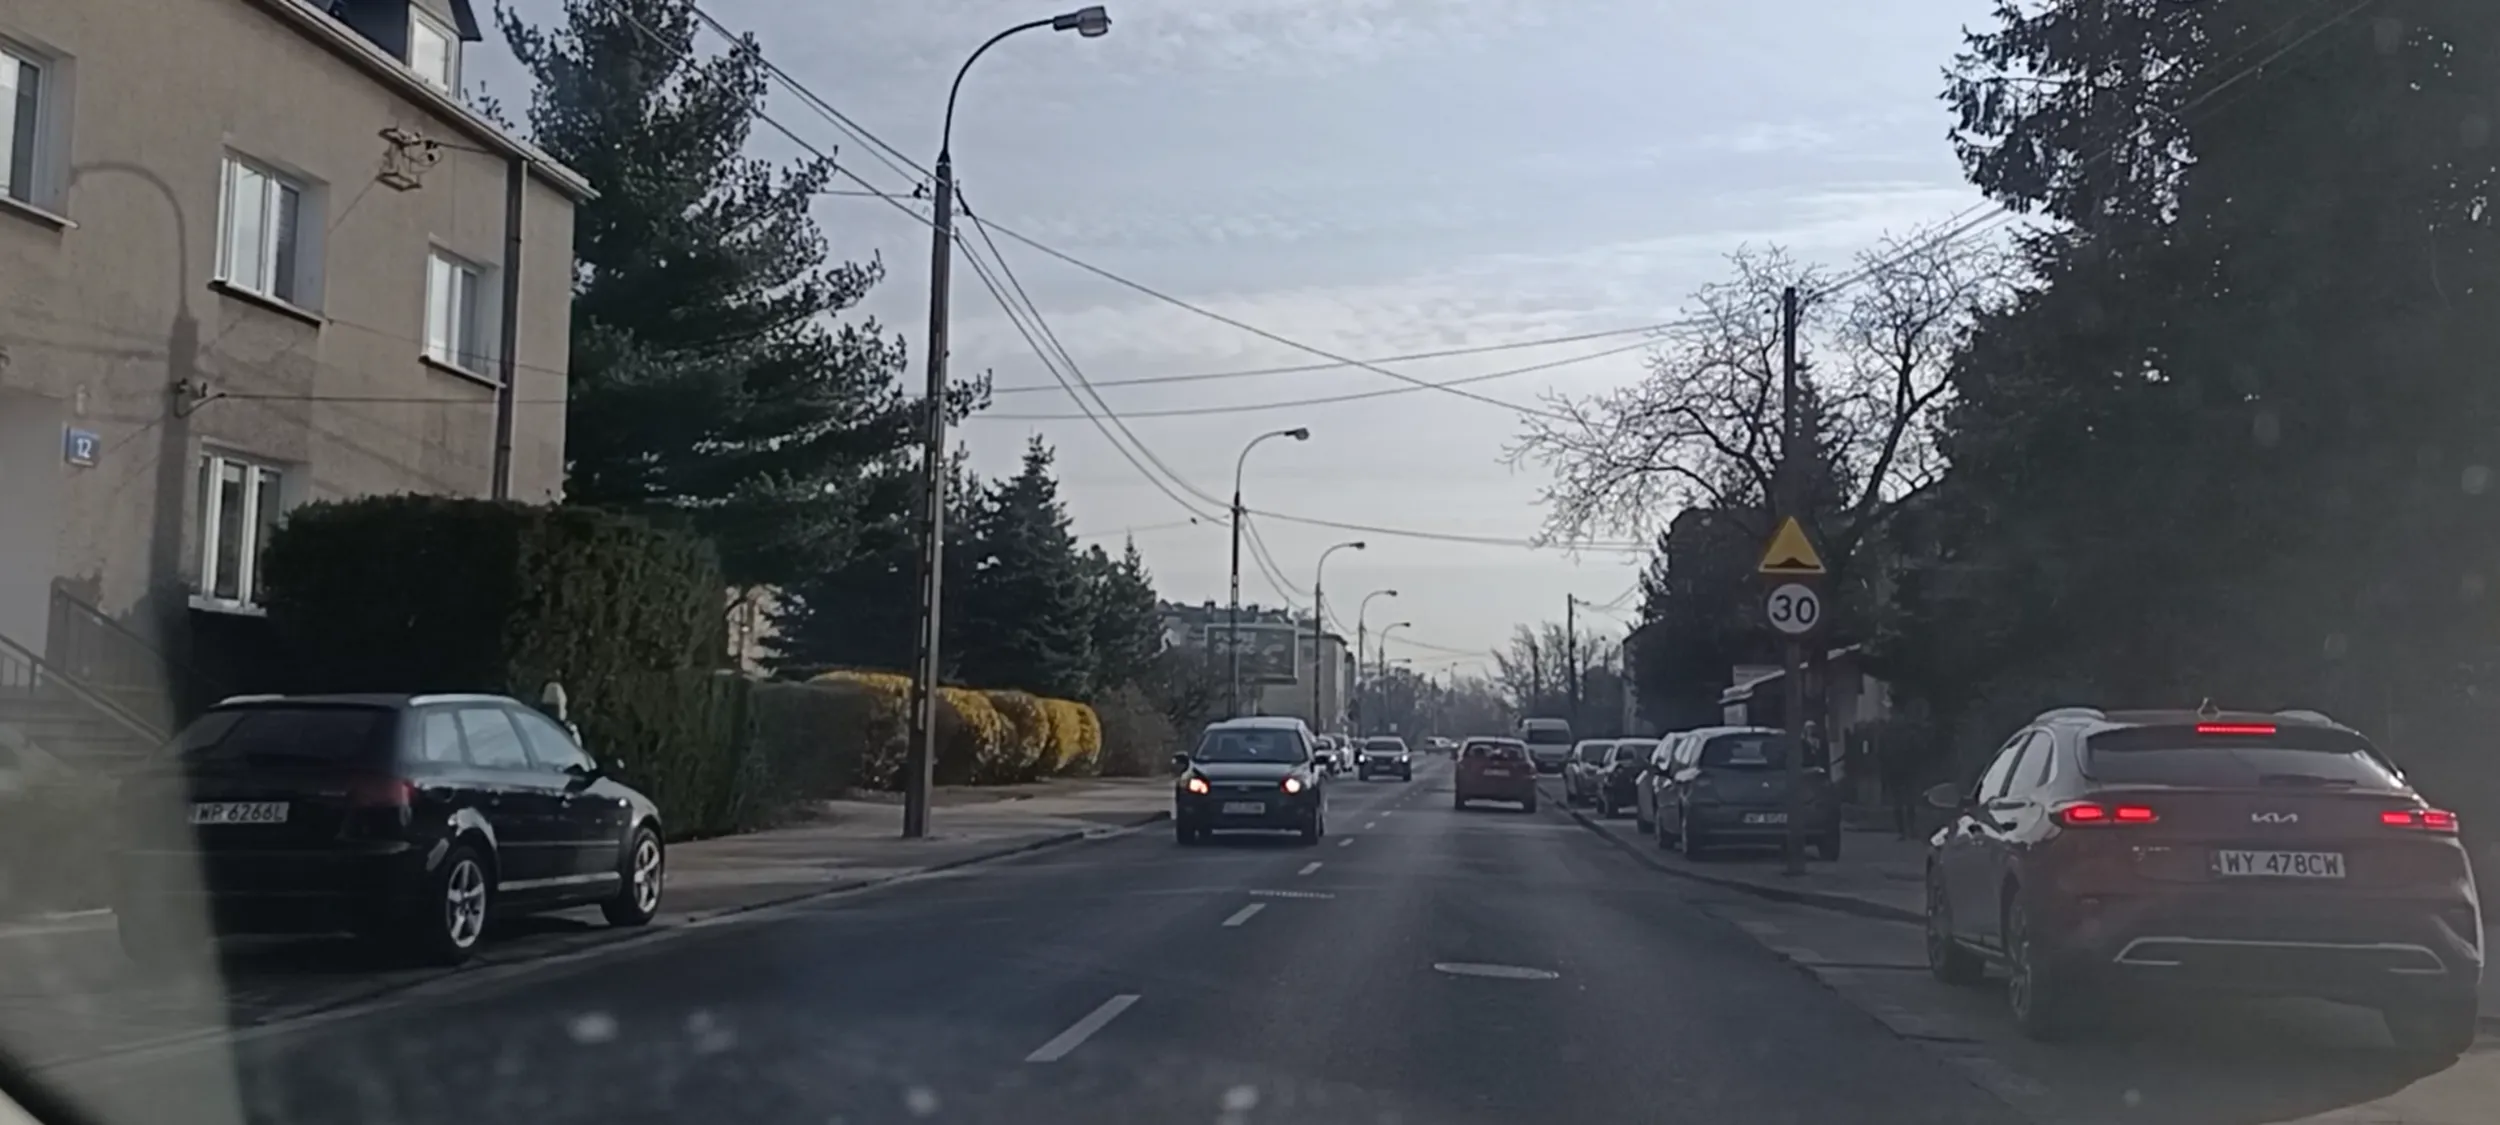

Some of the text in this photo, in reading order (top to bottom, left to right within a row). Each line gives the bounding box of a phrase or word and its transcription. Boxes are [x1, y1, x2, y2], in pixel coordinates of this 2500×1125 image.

[77, 438, 92, 459] 12
[1771, 594, 1816, 624] 30
[199, 803, 283, 821] WP 6266L
[2225, 853, 2338, 875] WY 478CW
